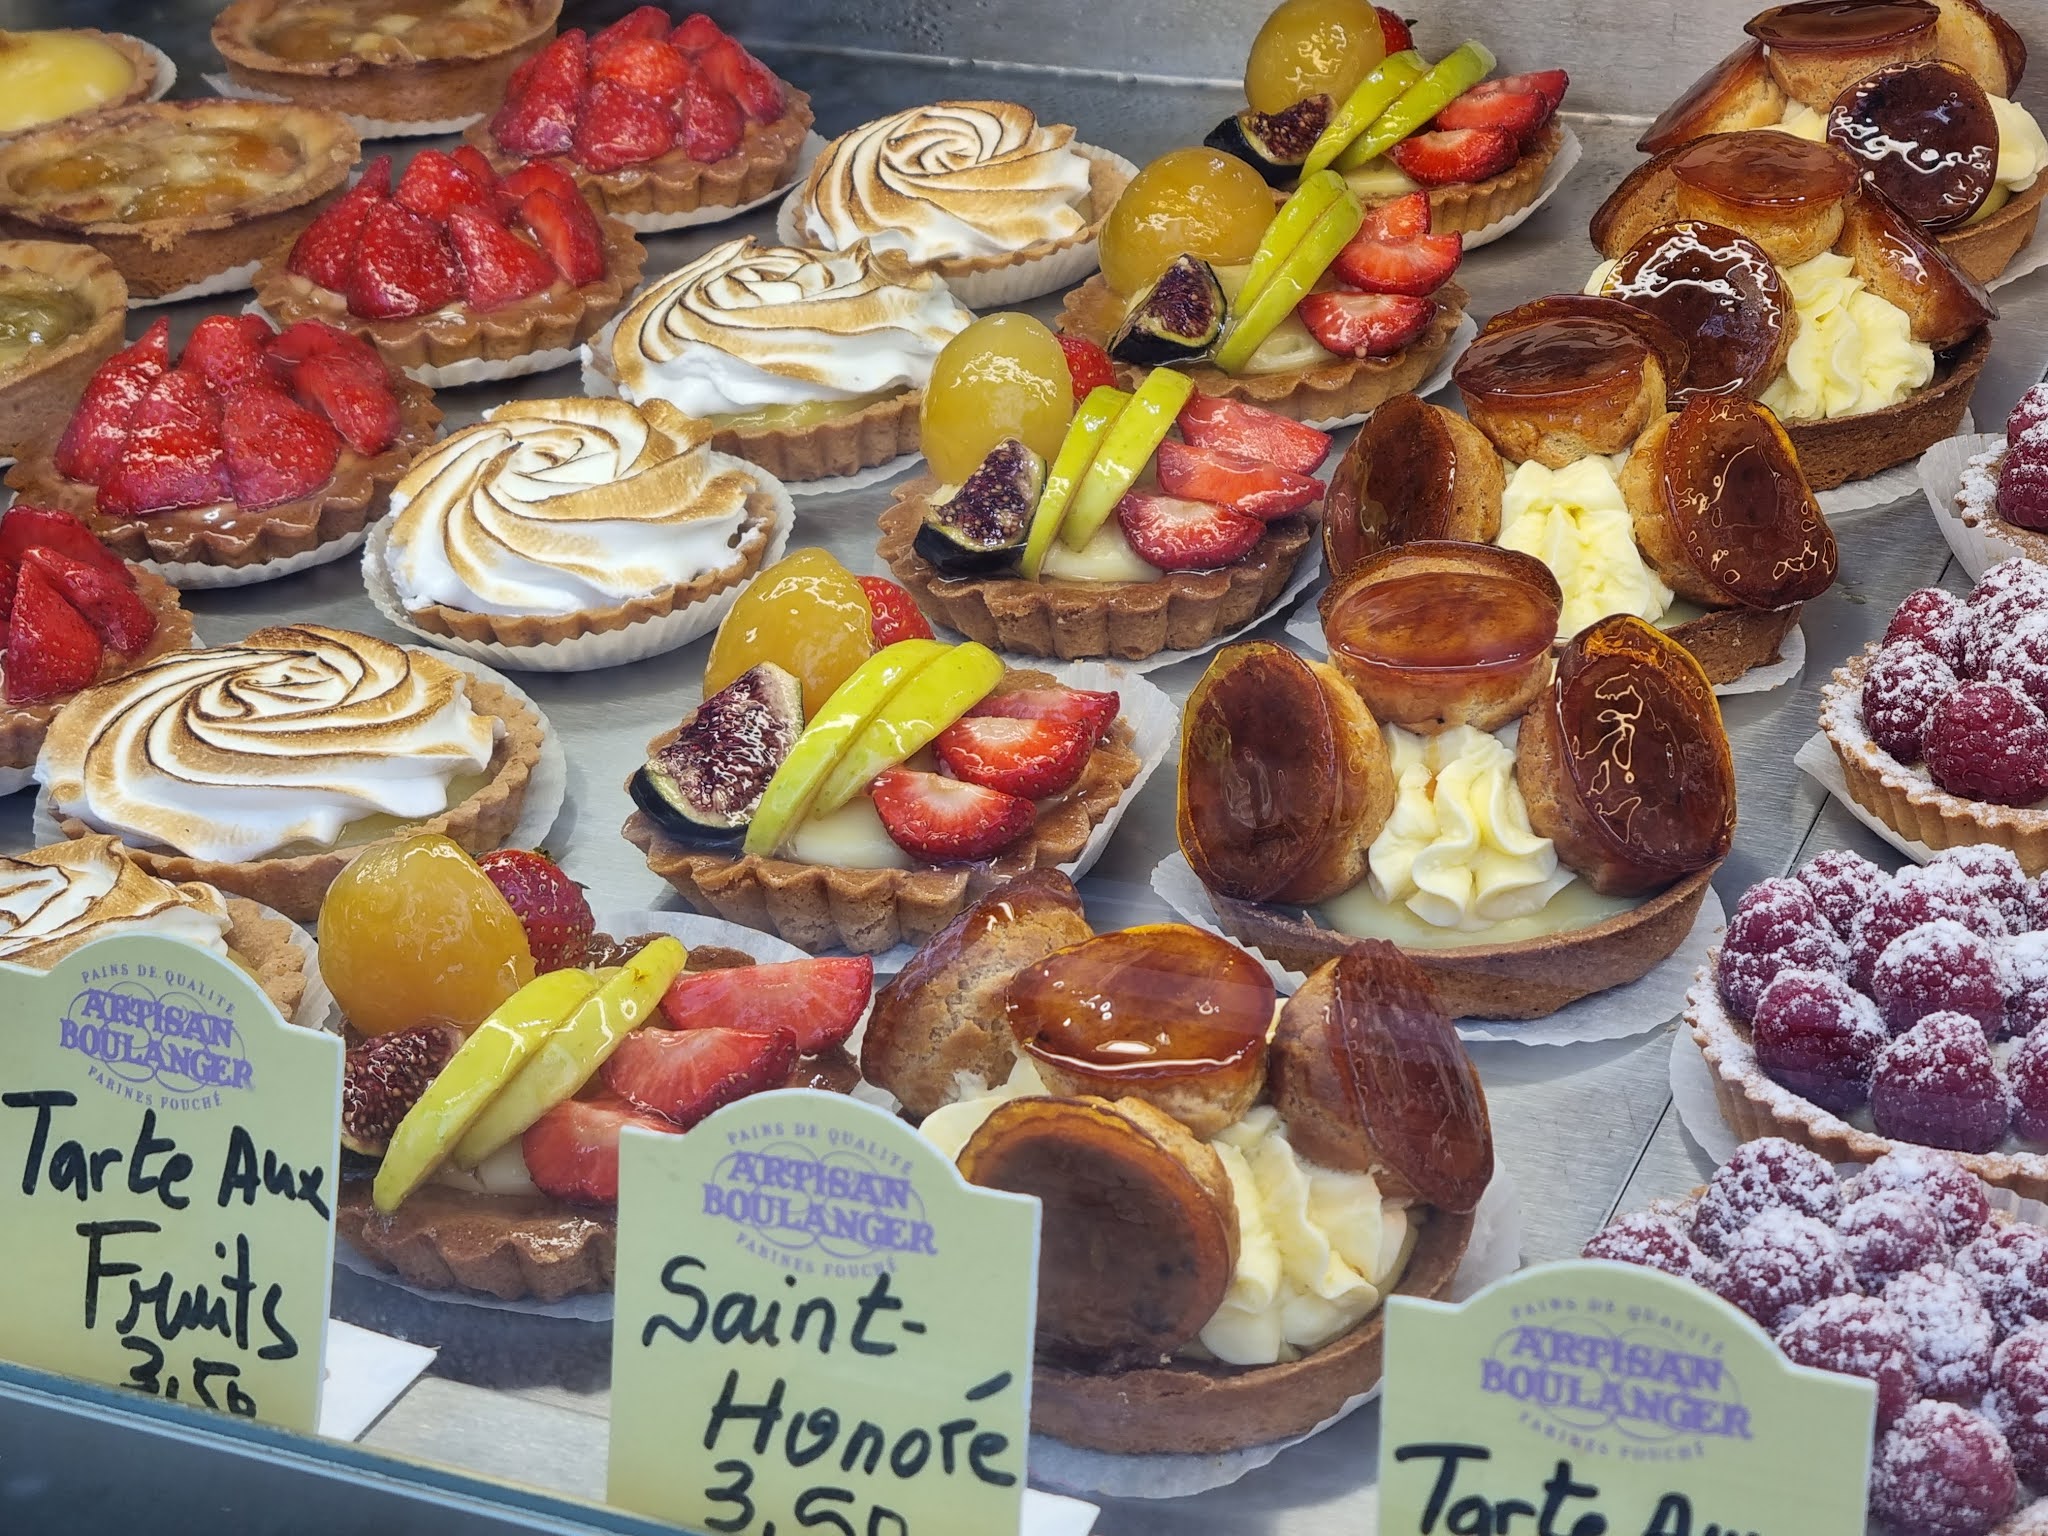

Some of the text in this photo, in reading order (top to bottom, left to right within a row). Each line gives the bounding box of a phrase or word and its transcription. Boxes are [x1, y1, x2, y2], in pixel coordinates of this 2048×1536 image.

[82, 964, 129, 984] PAINS
[138, 964, 157, 978] DE
[60, 1018, 254, 1089] BOULANGER
[81, 988, 233, 1048] ARTISAN
[88, 1065, 153, 1106] FARINES
[1, 1090, 330, 1221] Tarte Aux
[728, 1122, 784, 1145] PAINS
[795, 1123, 818, 1138] DE
[728, 1151, 911, 1210] ARTISAN
[702, 1183, 938, 1256] BOULANGER
[76, 1220, 299, 1361] Fruits
[642, 1255, 926, 1356] Saint-
[1511, 1325, 1724, 1391] ARTISAN
[703, 1369, 1017, 1488] Honoré
[1480, 1357, 1754, 1441] BOULANGER
